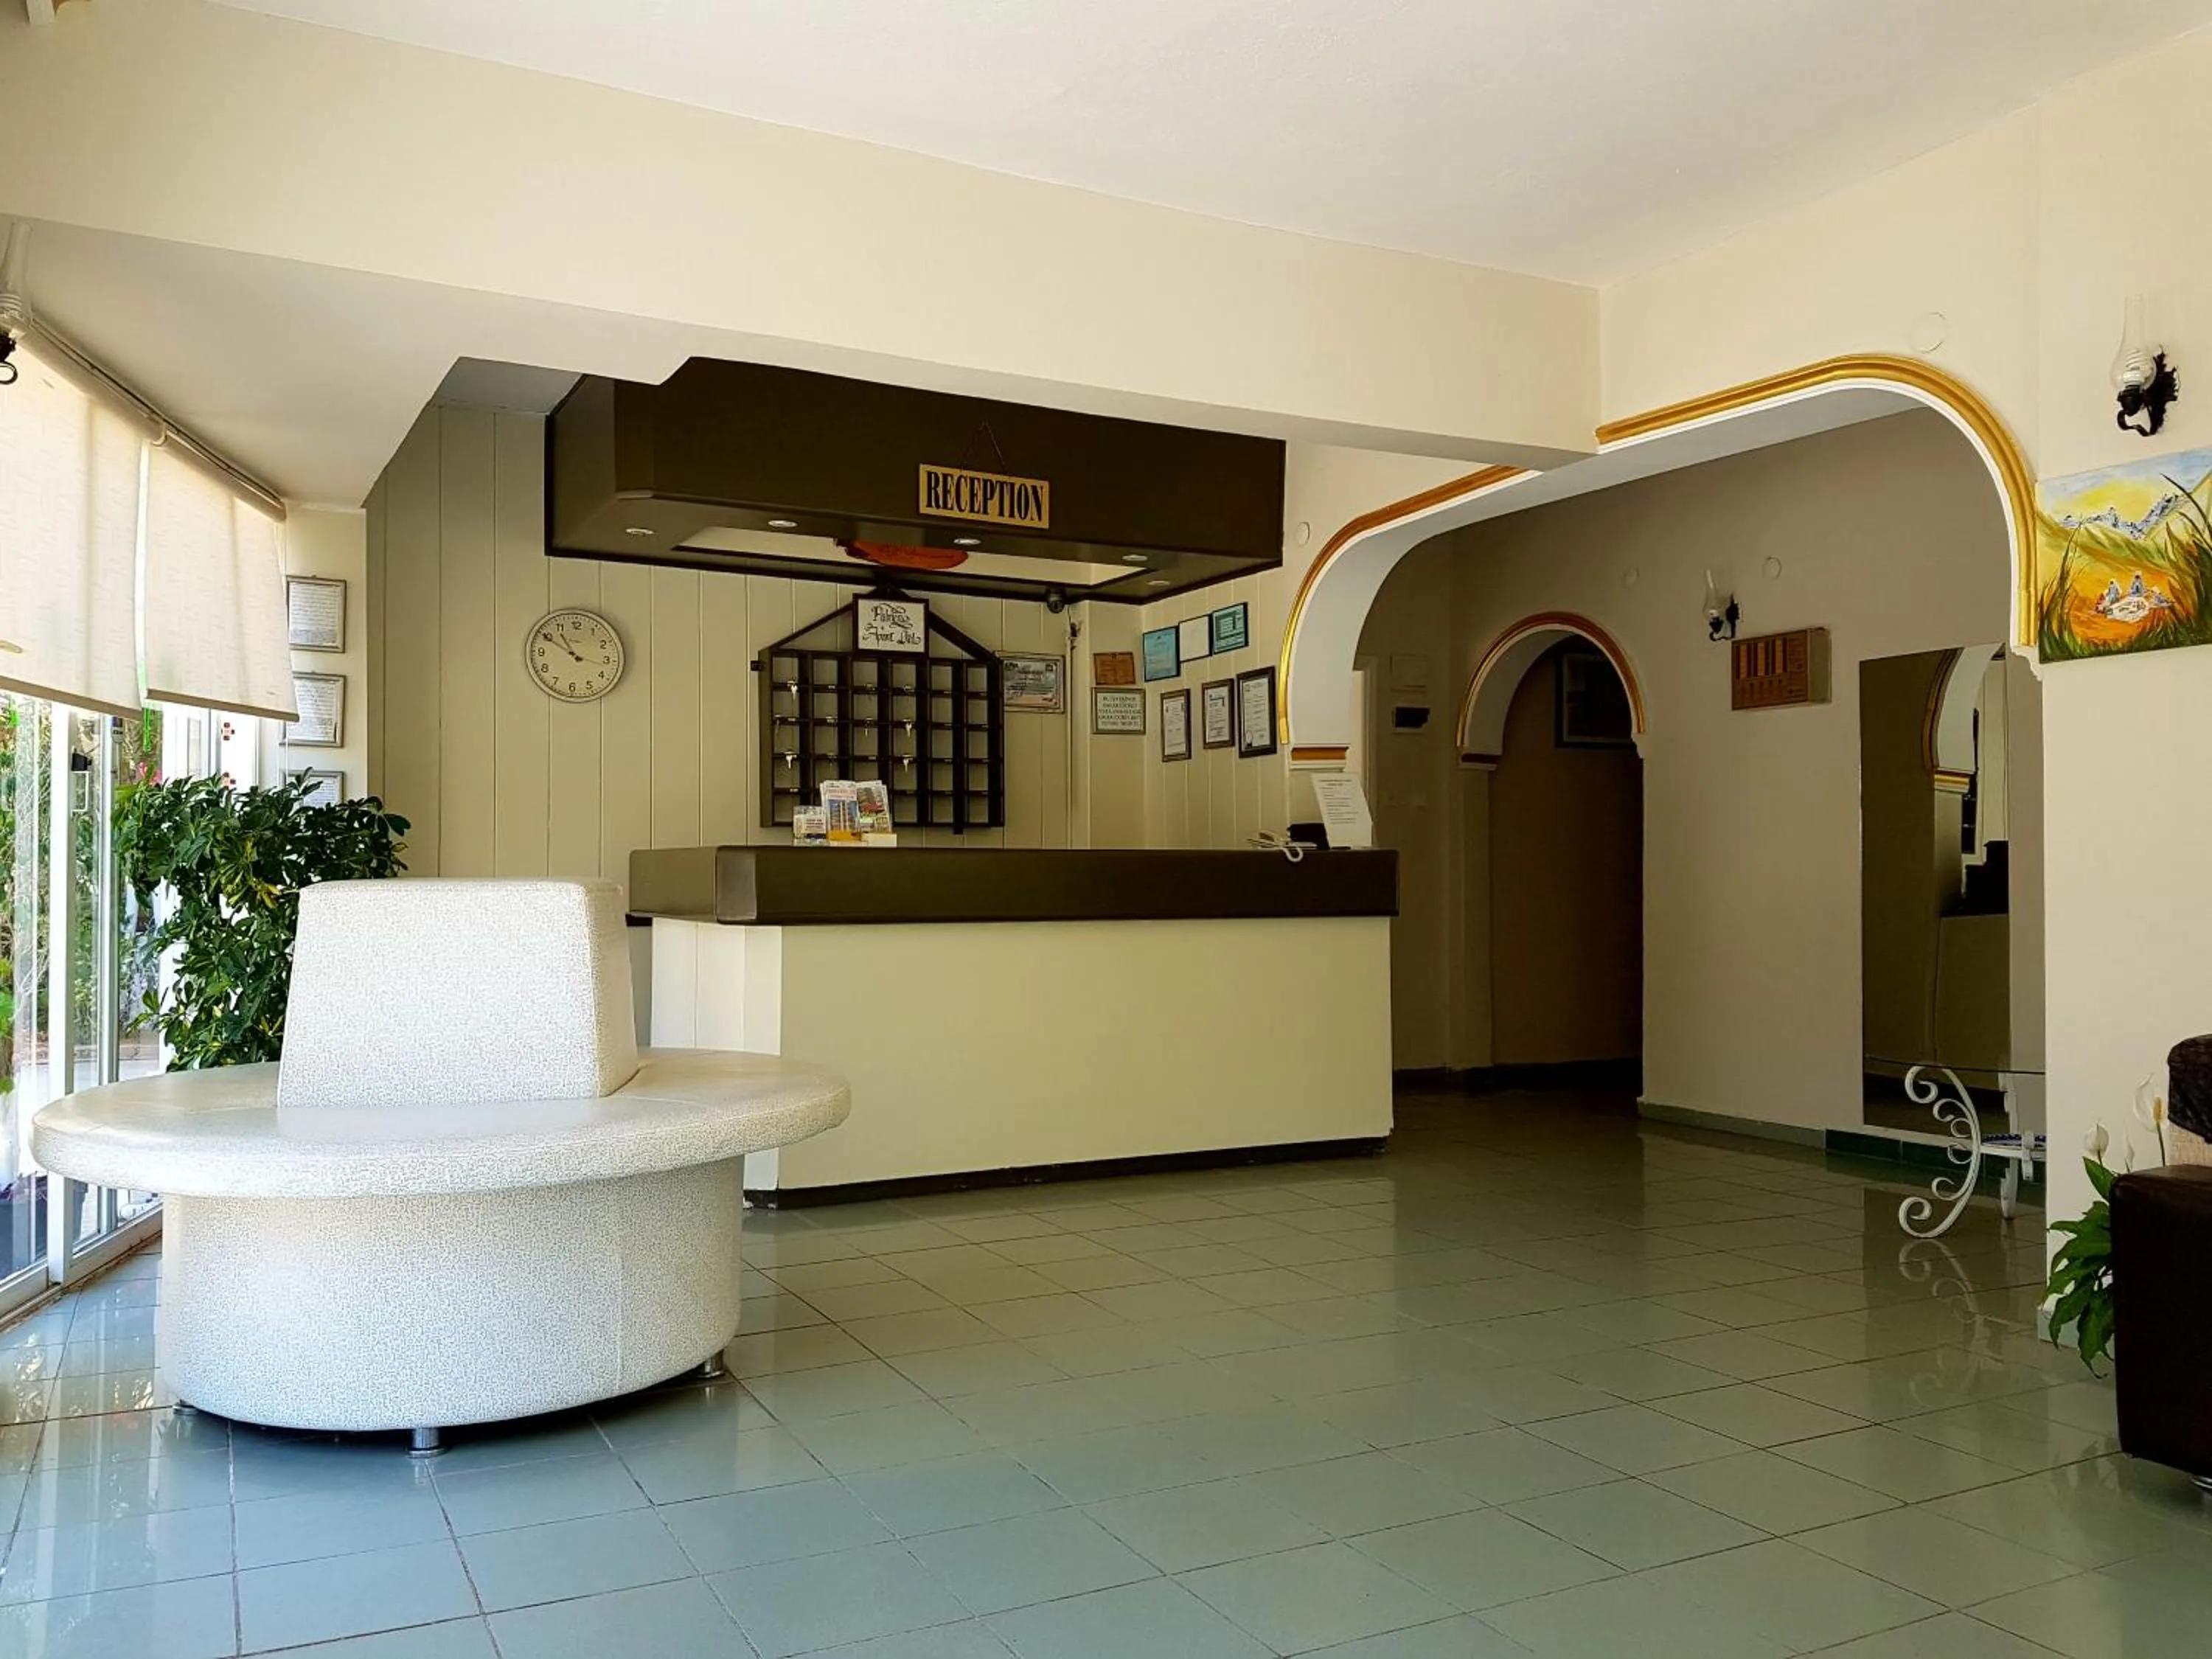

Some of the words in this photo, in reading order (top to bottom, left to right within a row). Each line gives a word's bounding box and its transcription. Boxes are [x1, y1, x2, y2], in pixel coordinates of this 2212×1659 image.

[925, 470, 1044, 522] RECEPTION
[556, 623, 564, 632] 11
[571, 622, 582, 630] 12
[599, 640, 607, 649] 2
[538, 647, 545, 656] 9
[603, 655, 610, 664] 3
[540, 664, 549, 672] 8
[598, 671, 605, 679] 4
[552, 676, 559, 685] 7
[586, 681, 594, 689] 5
[568, 683, 576, 692] 6
